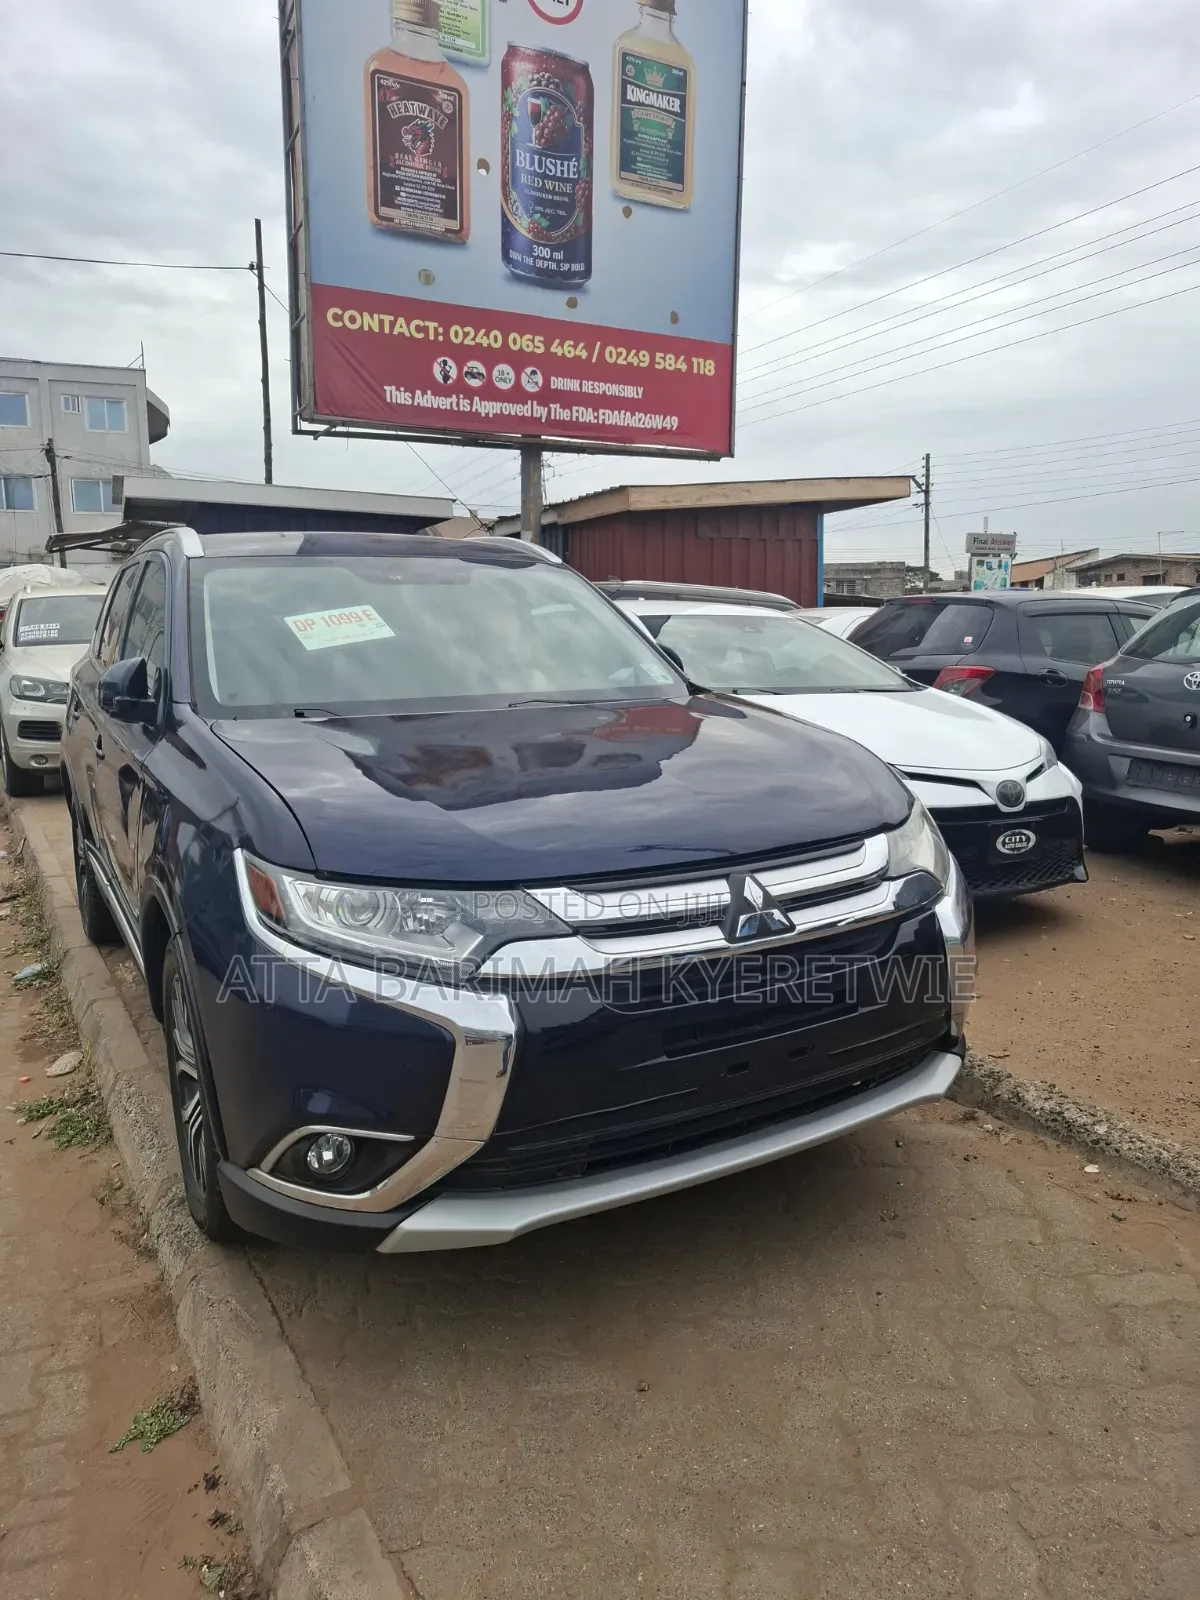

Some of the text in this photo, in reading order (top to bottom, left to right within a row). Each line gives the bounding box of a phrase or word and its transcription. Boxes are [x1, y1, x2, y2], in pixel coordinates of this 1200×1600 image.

[626, 84, 680, 112] KINGMAKER
[387, 100, 448, 130] HEATWAVE
[394, 152, 442, 168] REAL GINGER
[516, 148, 578, 178] BLUSHÉ
[521, 174, 572, 193] RED WINE
[509, 250, 521, 262] OWN
[523, 256, 534, 266] THE
[536, 259, 558, 270] DEPTH.
[560, 263, 569, 271] SIP
[532, 245, 564, 260] 300 ml
[326, 307, 716, 376] CONTACT: 0240 065 464 / 0249 584 118
[495, 376, 513, 385] ONLY
[550, 376, 644, 399] DRINK RESPONSIBLY
[384, 386, 678, 430] This Advert is Approved by The FDA: FDAfAd26W49
[973, 537, 988, 545] Final
[292, 618, 316, 632] DP
[320, 611, 363, 628] 1099
[1005, 835, 1028, 843] CITY
